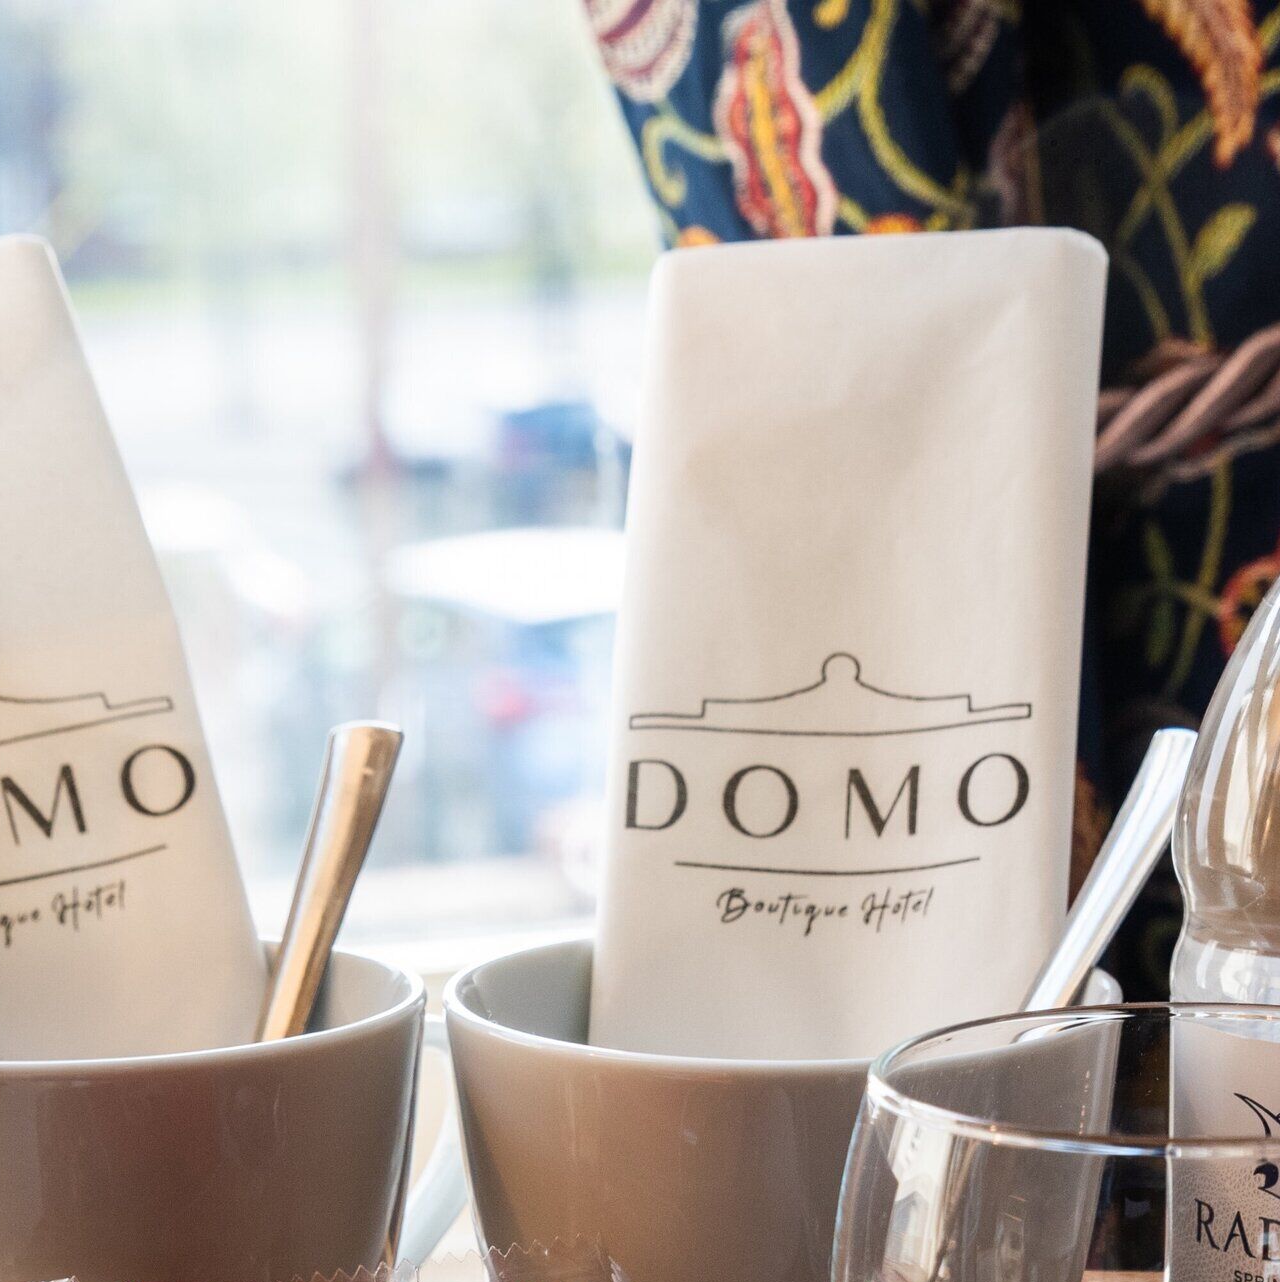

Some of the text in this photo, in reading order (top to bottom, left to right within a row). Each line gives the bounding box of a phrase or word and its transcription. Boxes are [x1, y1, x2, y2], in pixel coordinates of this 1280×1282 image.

[625, 753, 1031, 839] DOMO
[51, 879, 126, 932] Hotel
[716, 886, 935, 936] Boutique Hotel
